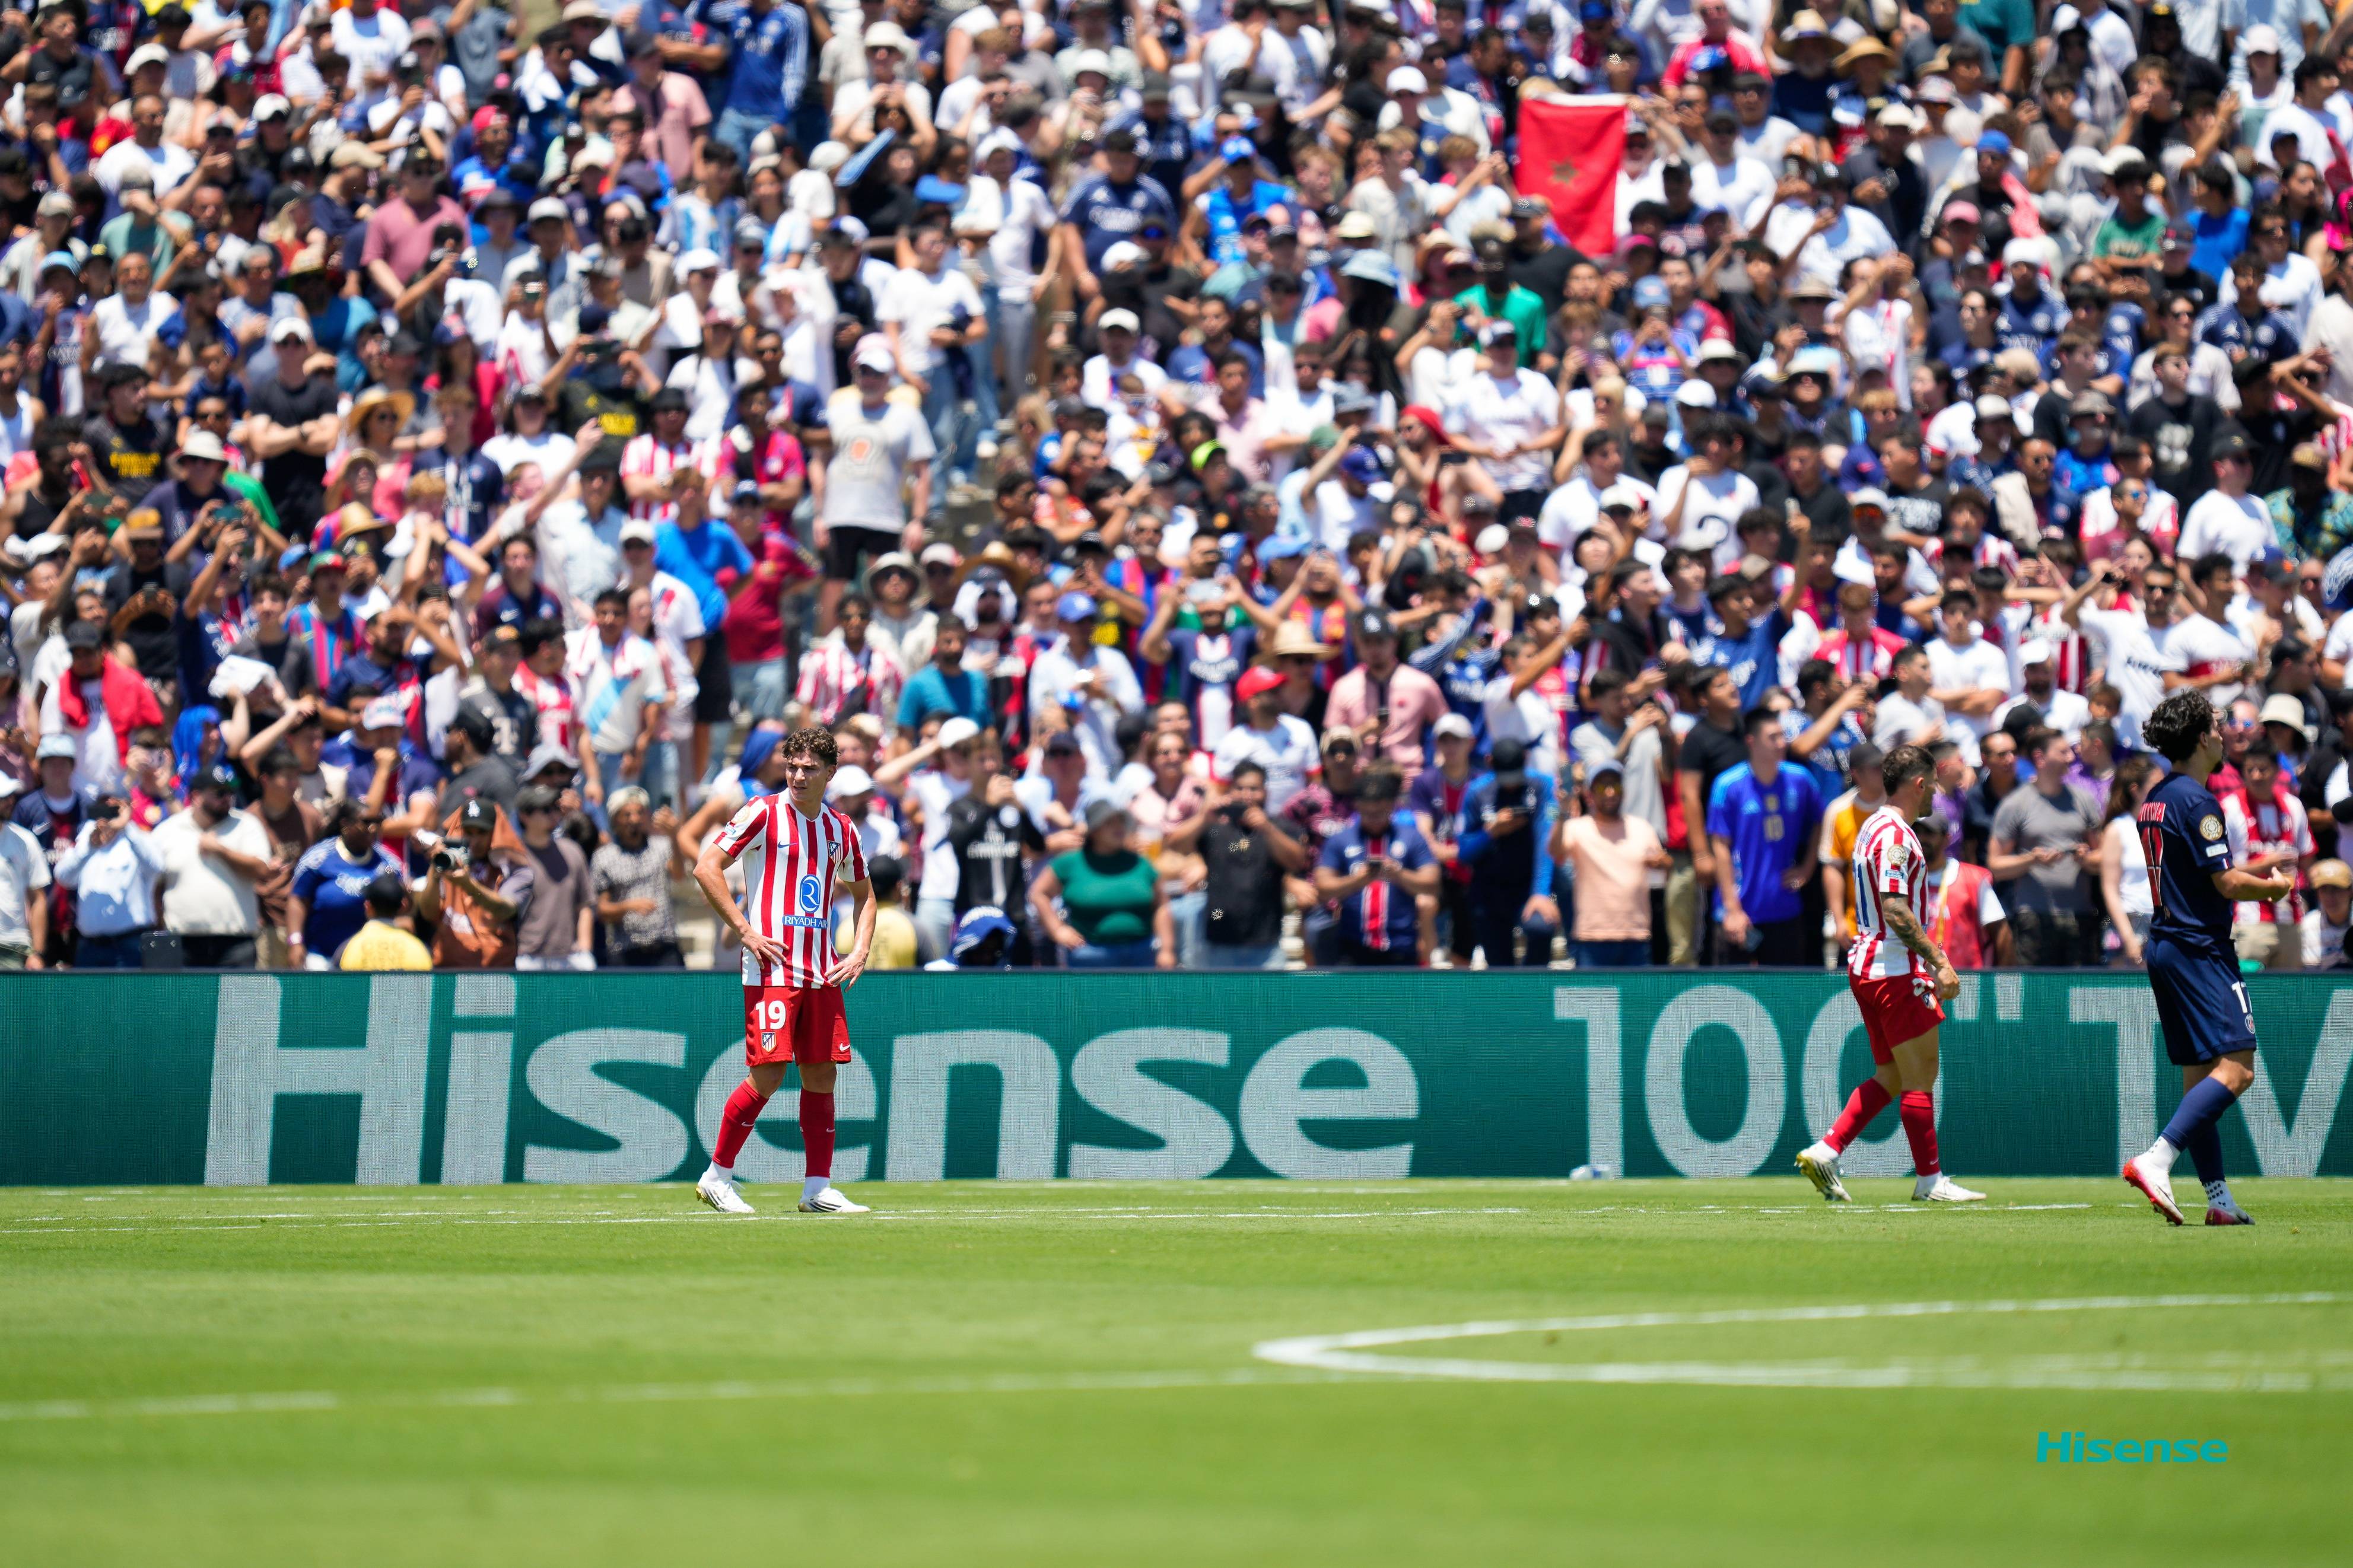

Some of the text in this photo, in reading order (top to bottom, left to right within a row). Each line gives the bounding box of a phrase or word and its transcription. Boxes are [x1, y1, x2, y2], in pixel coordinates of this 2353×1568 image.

[784, 915, 827, 928] RIYADH AIR
[755, 1000, 786, 1030] 19
[204, 974, 1419, 1185] Hisense
[2069, 987, 2353, 1178] TV
